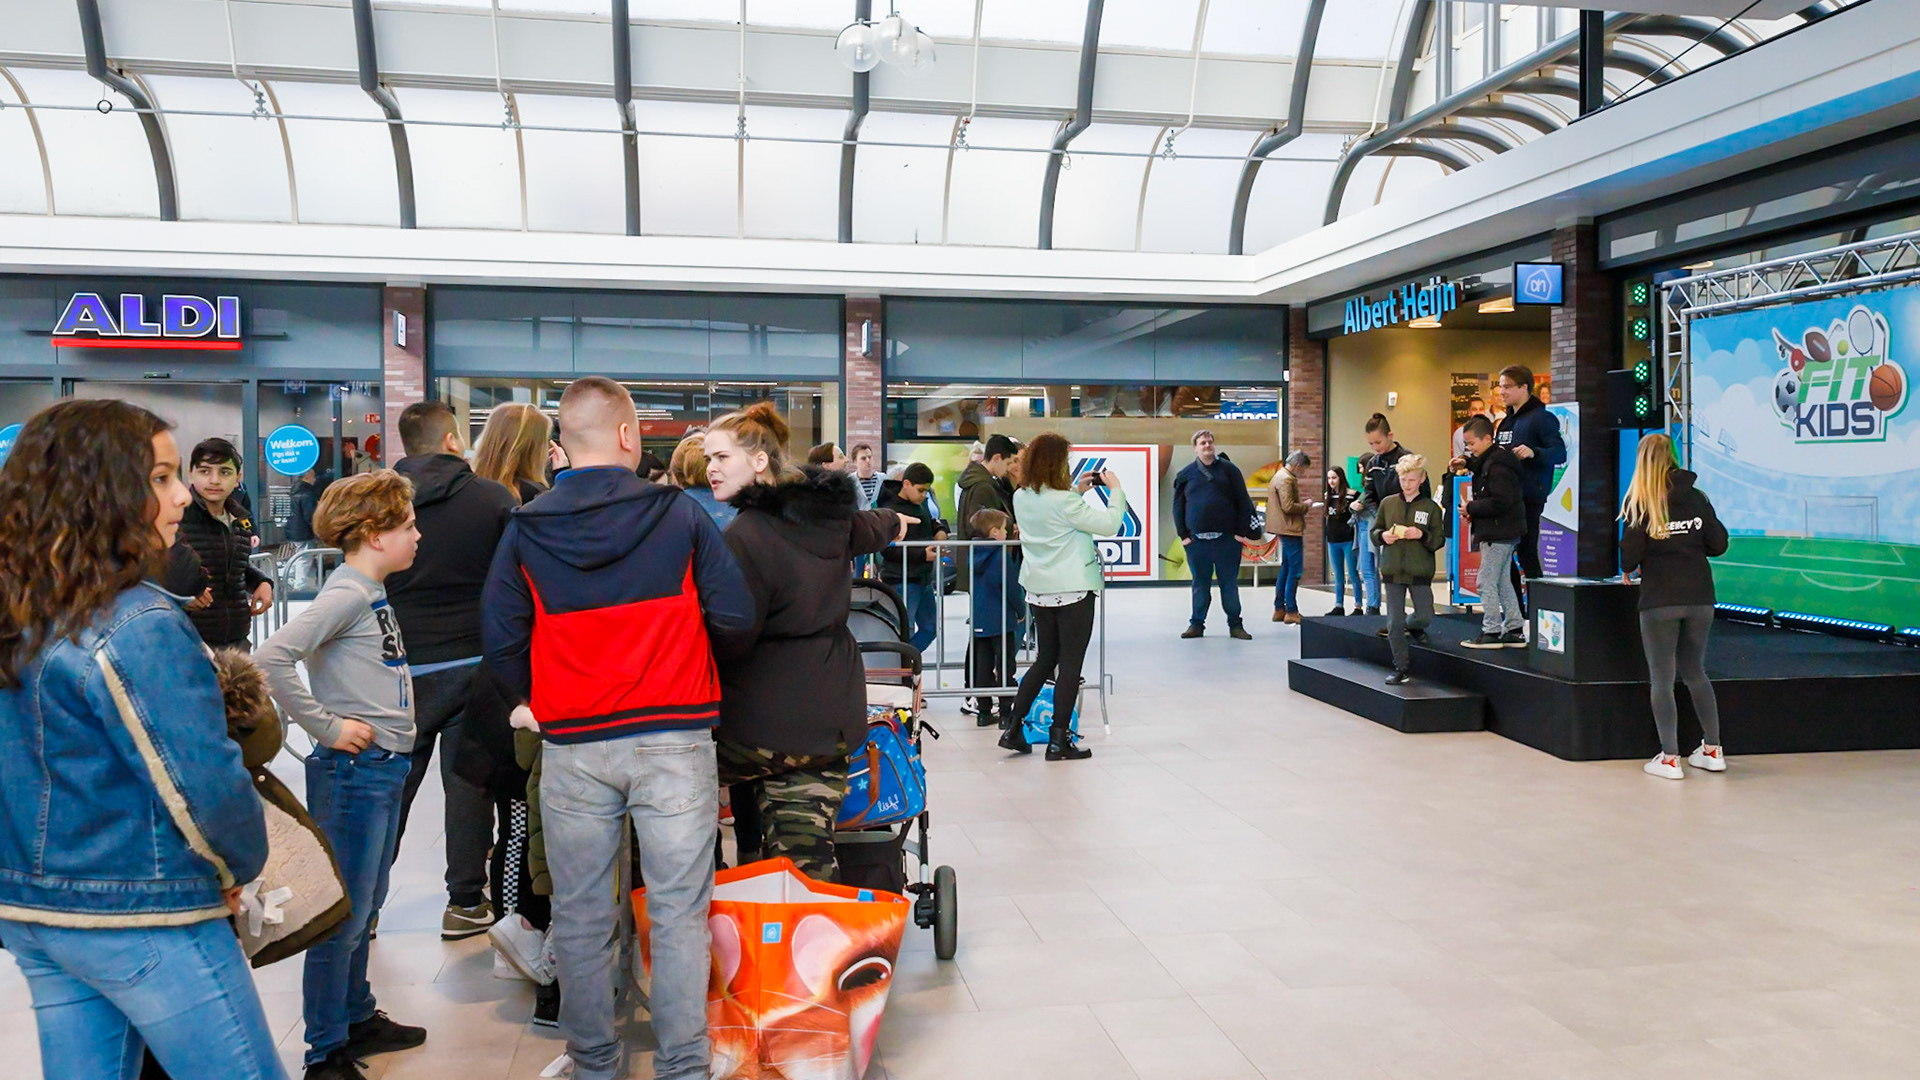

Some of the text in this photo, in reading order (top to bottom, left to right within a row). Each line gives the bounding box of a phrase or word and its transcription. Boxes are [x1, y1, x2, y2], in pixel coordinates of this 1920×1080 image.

[52, 292, 240, 338] ALDI
[1343, 275, 1456, 335] Albert Heijn
[1796, 401, 1875, 438] KIDS
[1096, 541, 1133, 564] DI
